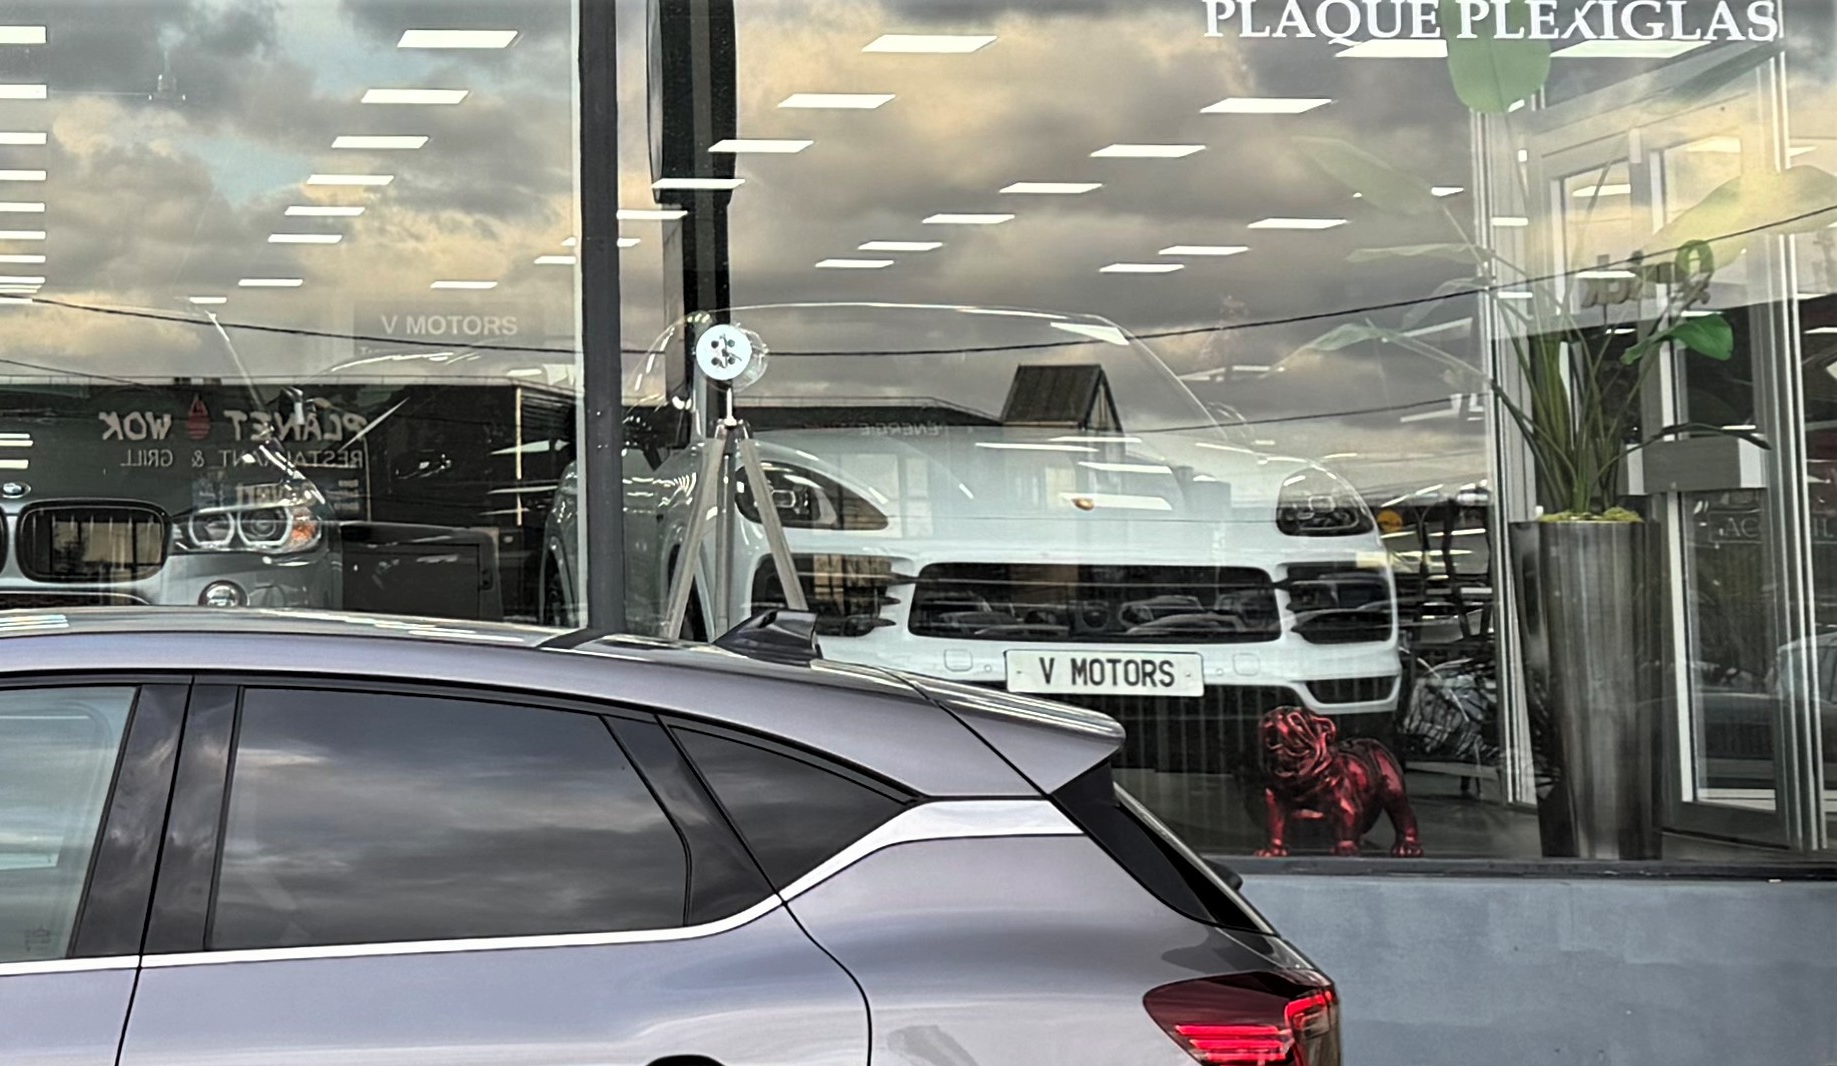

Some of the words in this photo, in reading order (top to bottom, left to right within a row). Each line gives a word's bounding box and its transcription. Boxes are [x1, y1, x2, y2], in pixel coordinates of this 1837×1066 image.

[1201, 0, 1441, 46] PLAQUE
[1456, 0, 1779, 42] PLEXIGLAS
[381, 315, 398, 336] V
[405, 314, 519, 337] MOTORS
[1039, 657, 1055, 686] V
[1070, 657, 1175, 688] MOTORS
